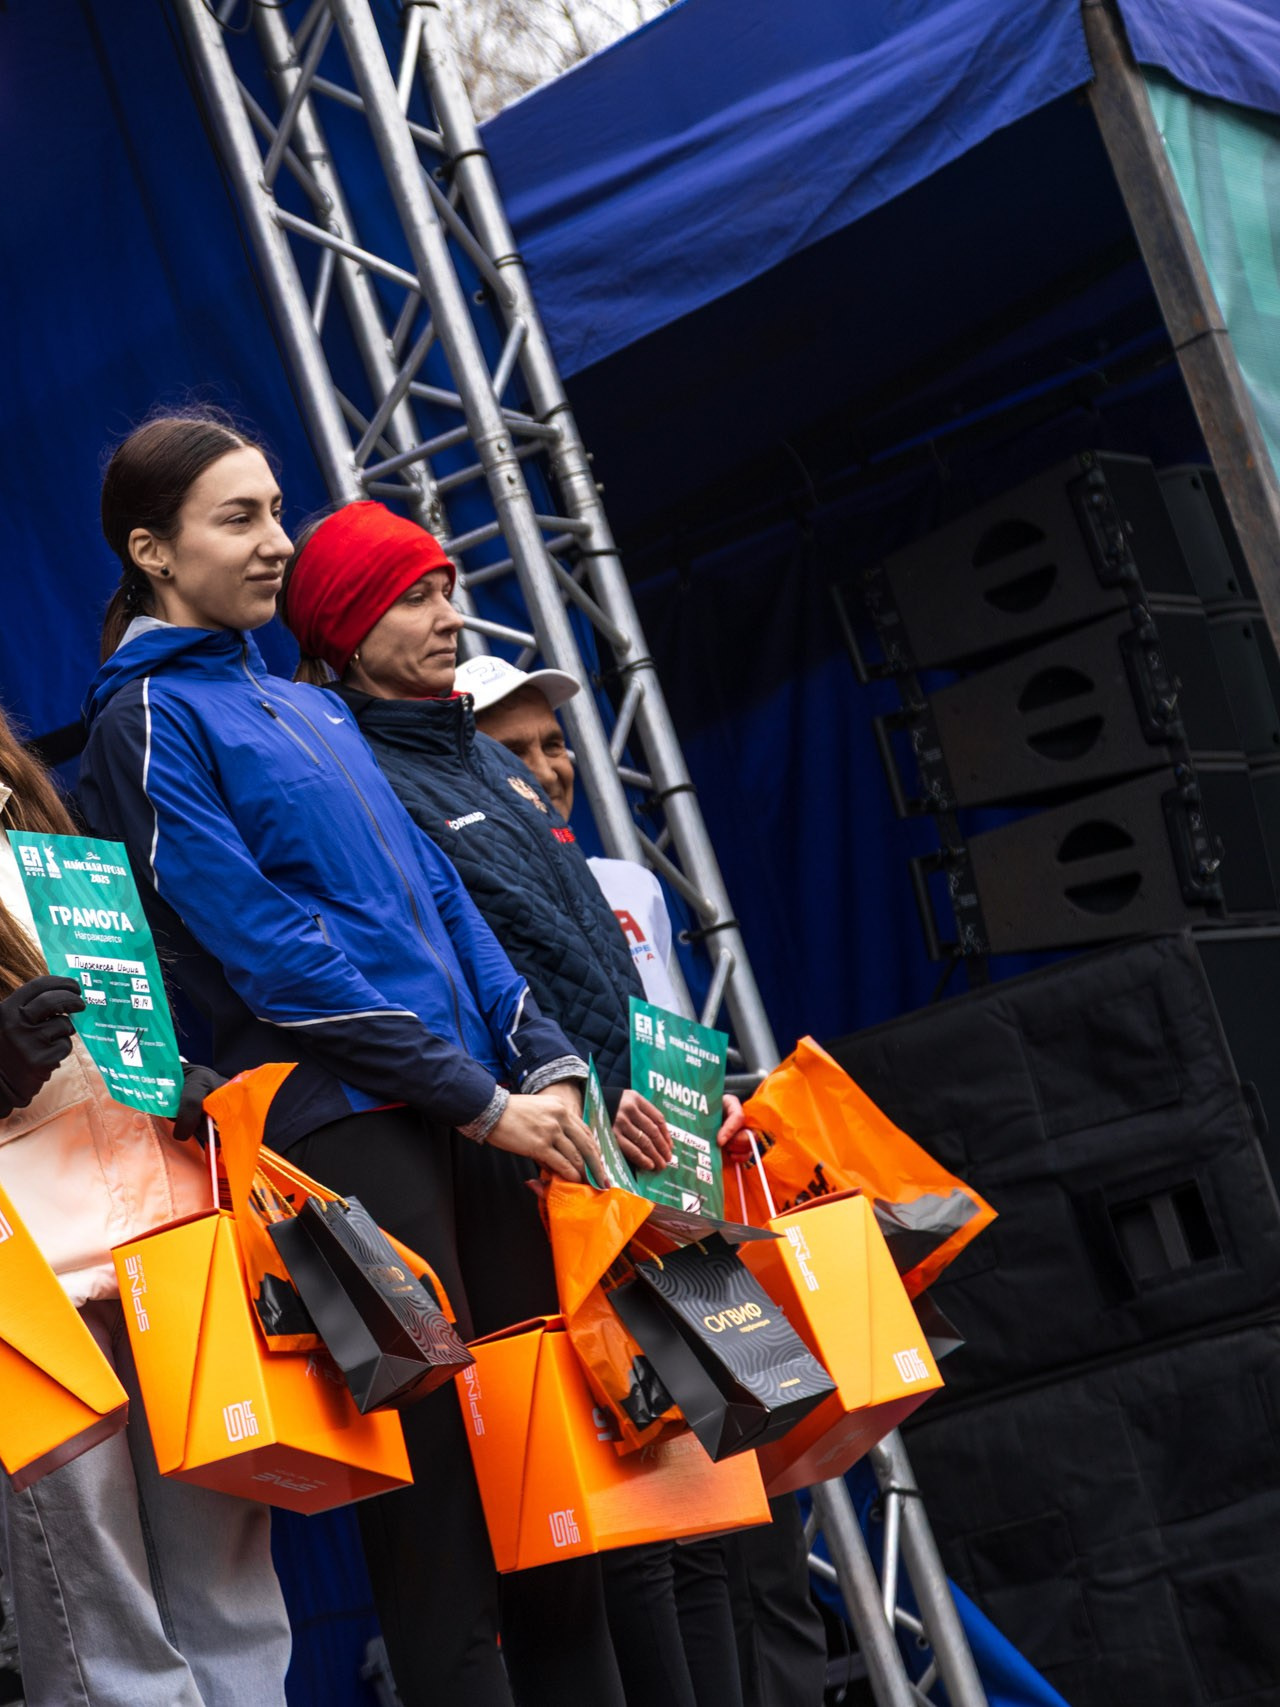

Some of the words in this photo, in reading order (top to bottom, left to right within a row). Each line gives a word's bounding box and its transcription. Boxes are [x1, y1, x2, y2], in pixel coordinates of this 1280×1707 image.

[48, 905, 135, 932] ГРАМОТА
[74, 931, 122, 944] Награждается
[648, 1069, 709, 1115] ГРАМОТА
[785, 1226, 819, 1291] SPINE
[125, 1256, 150, 1333] SPINE
[463, 1366, 486, 1436] SPINE
